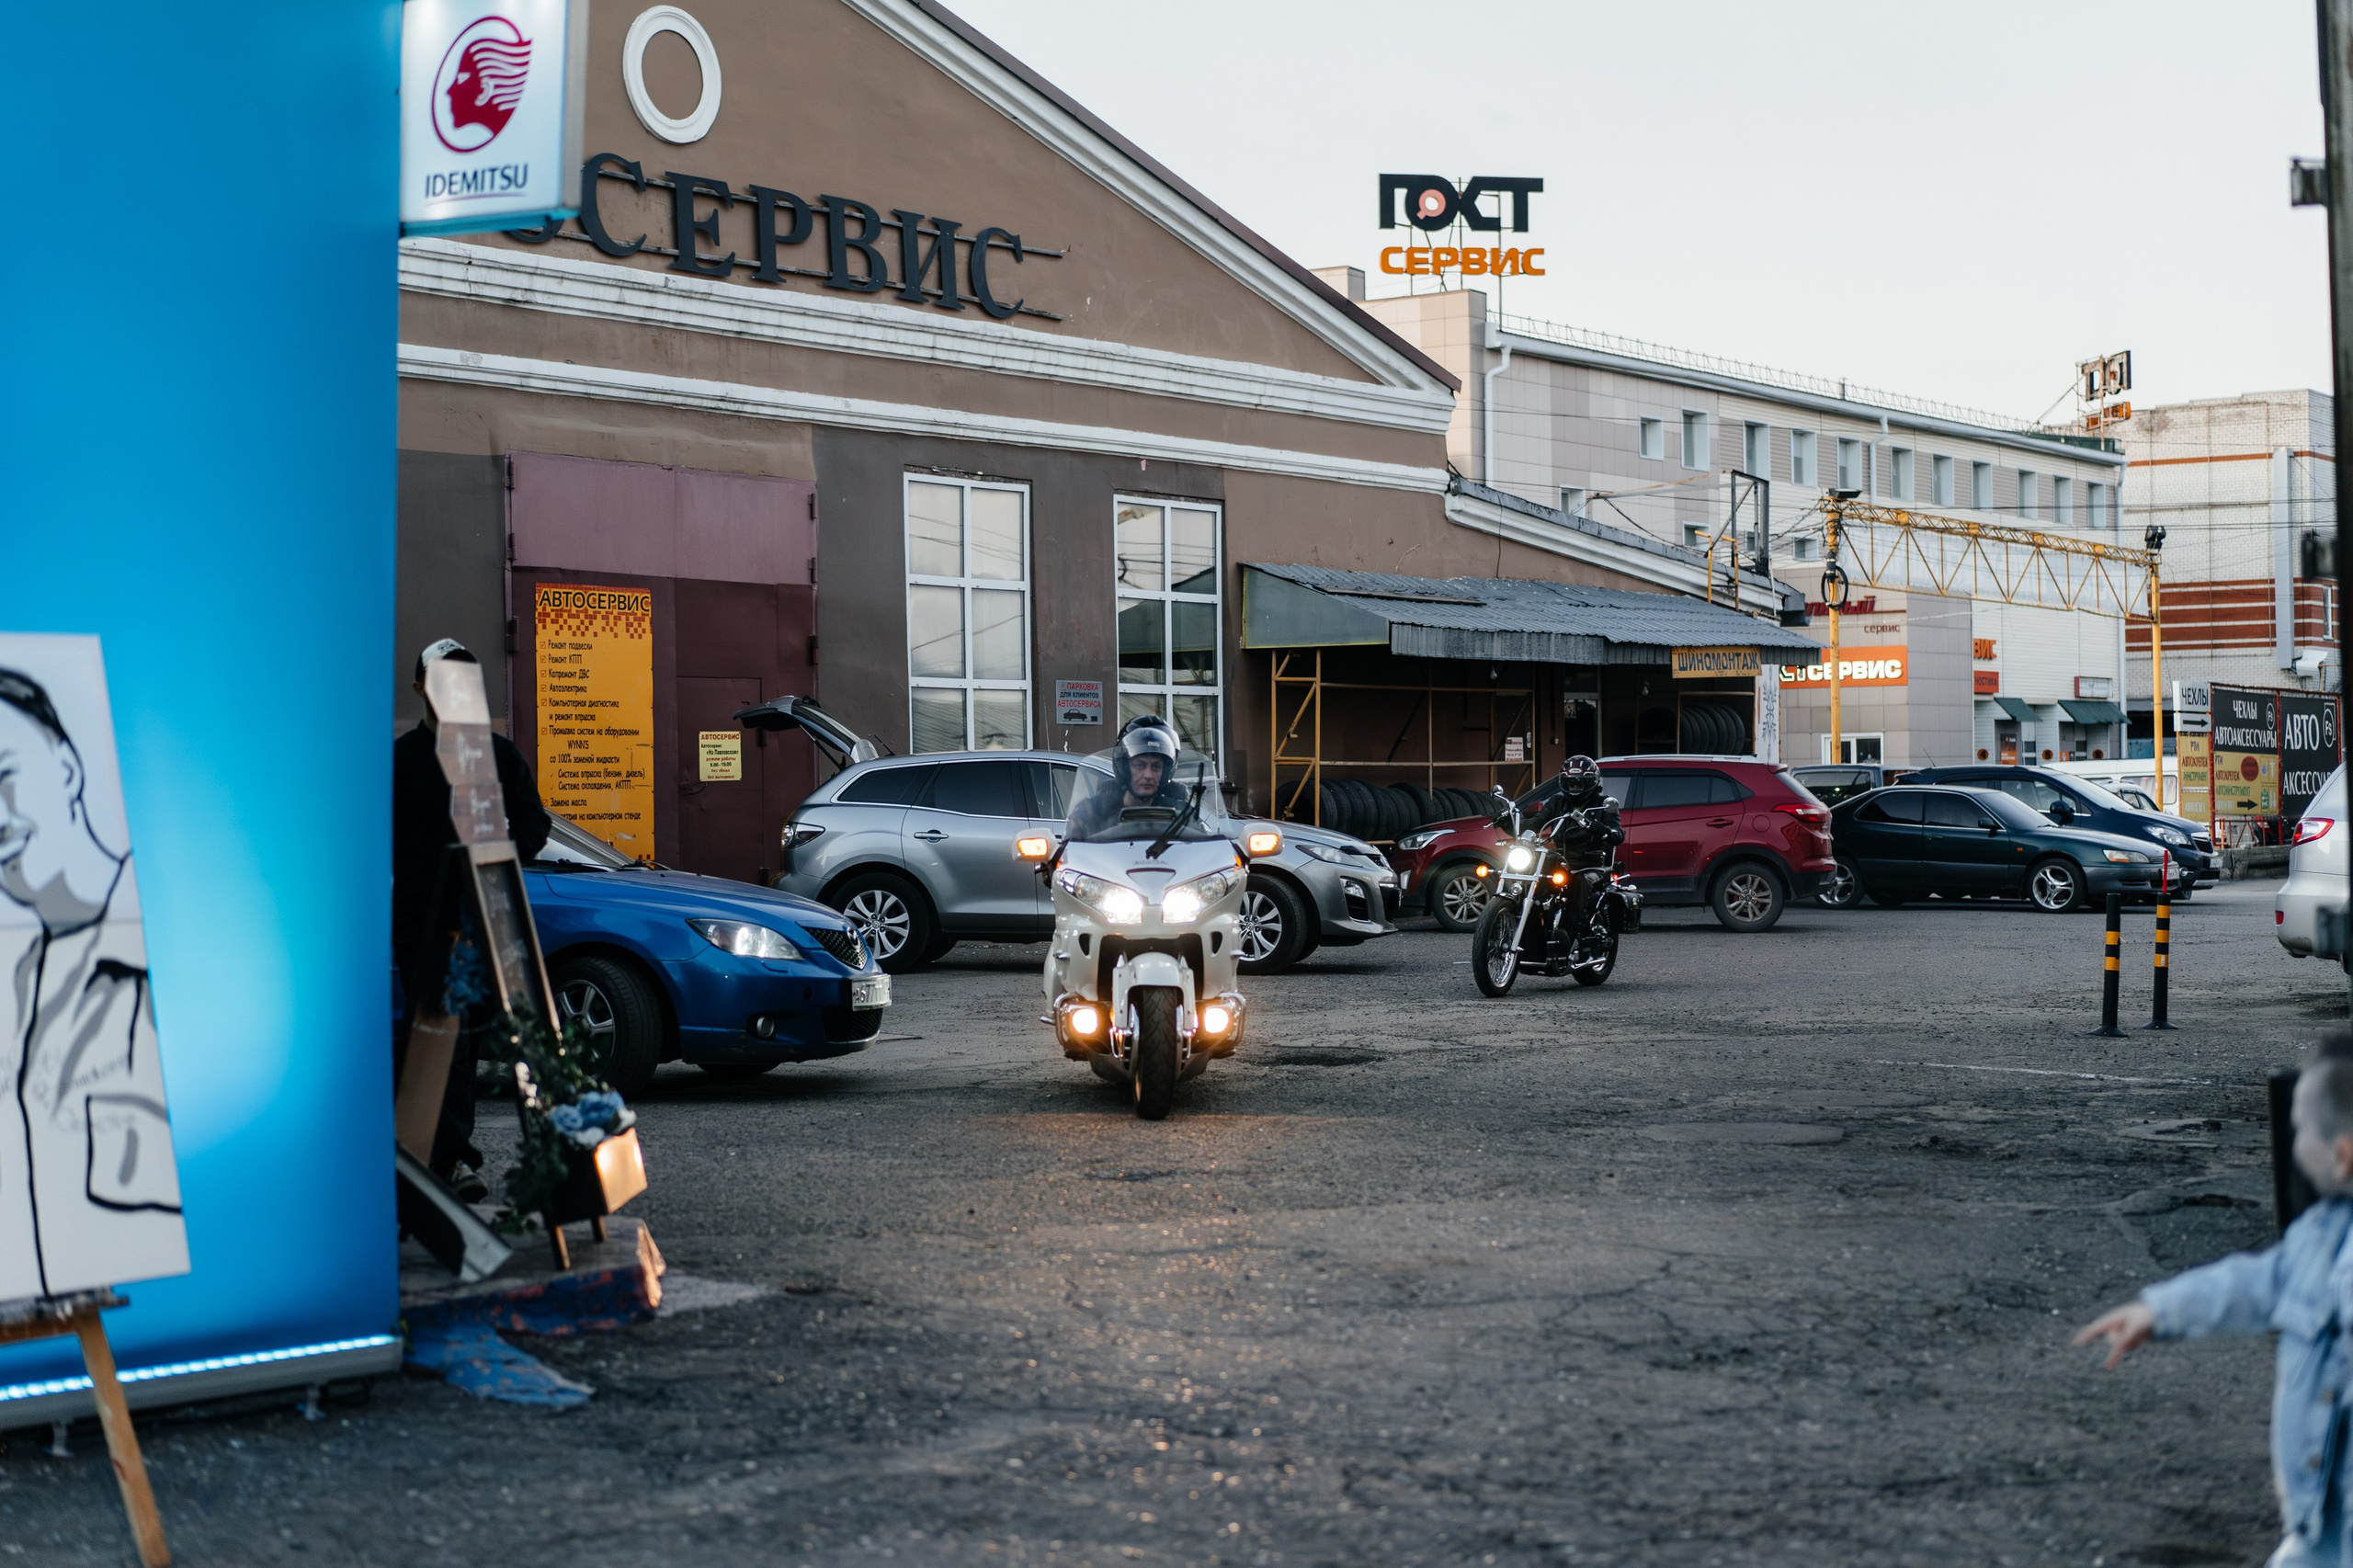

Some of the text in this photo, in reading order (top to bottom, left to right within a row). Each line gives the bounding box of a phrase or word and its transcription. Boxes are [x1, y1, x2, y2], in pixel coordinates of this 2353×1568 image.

[426, 164, 529, 199] IDEMITSU
[1379, 173, 1544, 233] ПОСТ
[505, 152, 1025, 320] СЕРВИС
[1380, 246, 1546, 276] СЕРВИС
[539, 589, 651, 612] АВТОСЕРВИС
[1863, 624, 1901, 635] сервис
[548, 639, 593, 651] Ремонт подвески
[548, 653, 583, 665] Ремонт КПП
[1677, 652, 1759, 672] ШИНОМОНТАЖ
[549, 668, 590, 681] Капремонт ДВС
[549, 683, 587, 696] Автоэлектрика
[1067, 682, 1098, 690] ПАРКОВКА
[549, 698, 620, 710] Компьютерная диагностика
[1058, 699, 1101, 708] АВТОСЕРВИСА
[2181, 688, 2209, 707] ЧЕХЛЫ
[2233, 699, 2257, 720] ЧЕХЛЫ
[549, 713, 597, 723] и ремонт впрыска
[549, 724, 575, 737] Промывка
[604, 726, 640, 738] оборудовании
[2214, 726, 2278, 748] АВТОАКСЕССУАРЫ
[2284, 713, 2320, 751] АВТО
[2189, 741, 2200, 752] РТИ
[550, 754, 620, 764] со 100% заменой жидкости
[558, 767, 645, 780] Система впрыска (бензин, дизель)
[558, 779, 631, 791] Система охлаждения, АКПП
[551, 798, 587, 807] Замена масла
[586, 812, 623, 823] компьютерном
[624, 812, 642, 821] стенде
